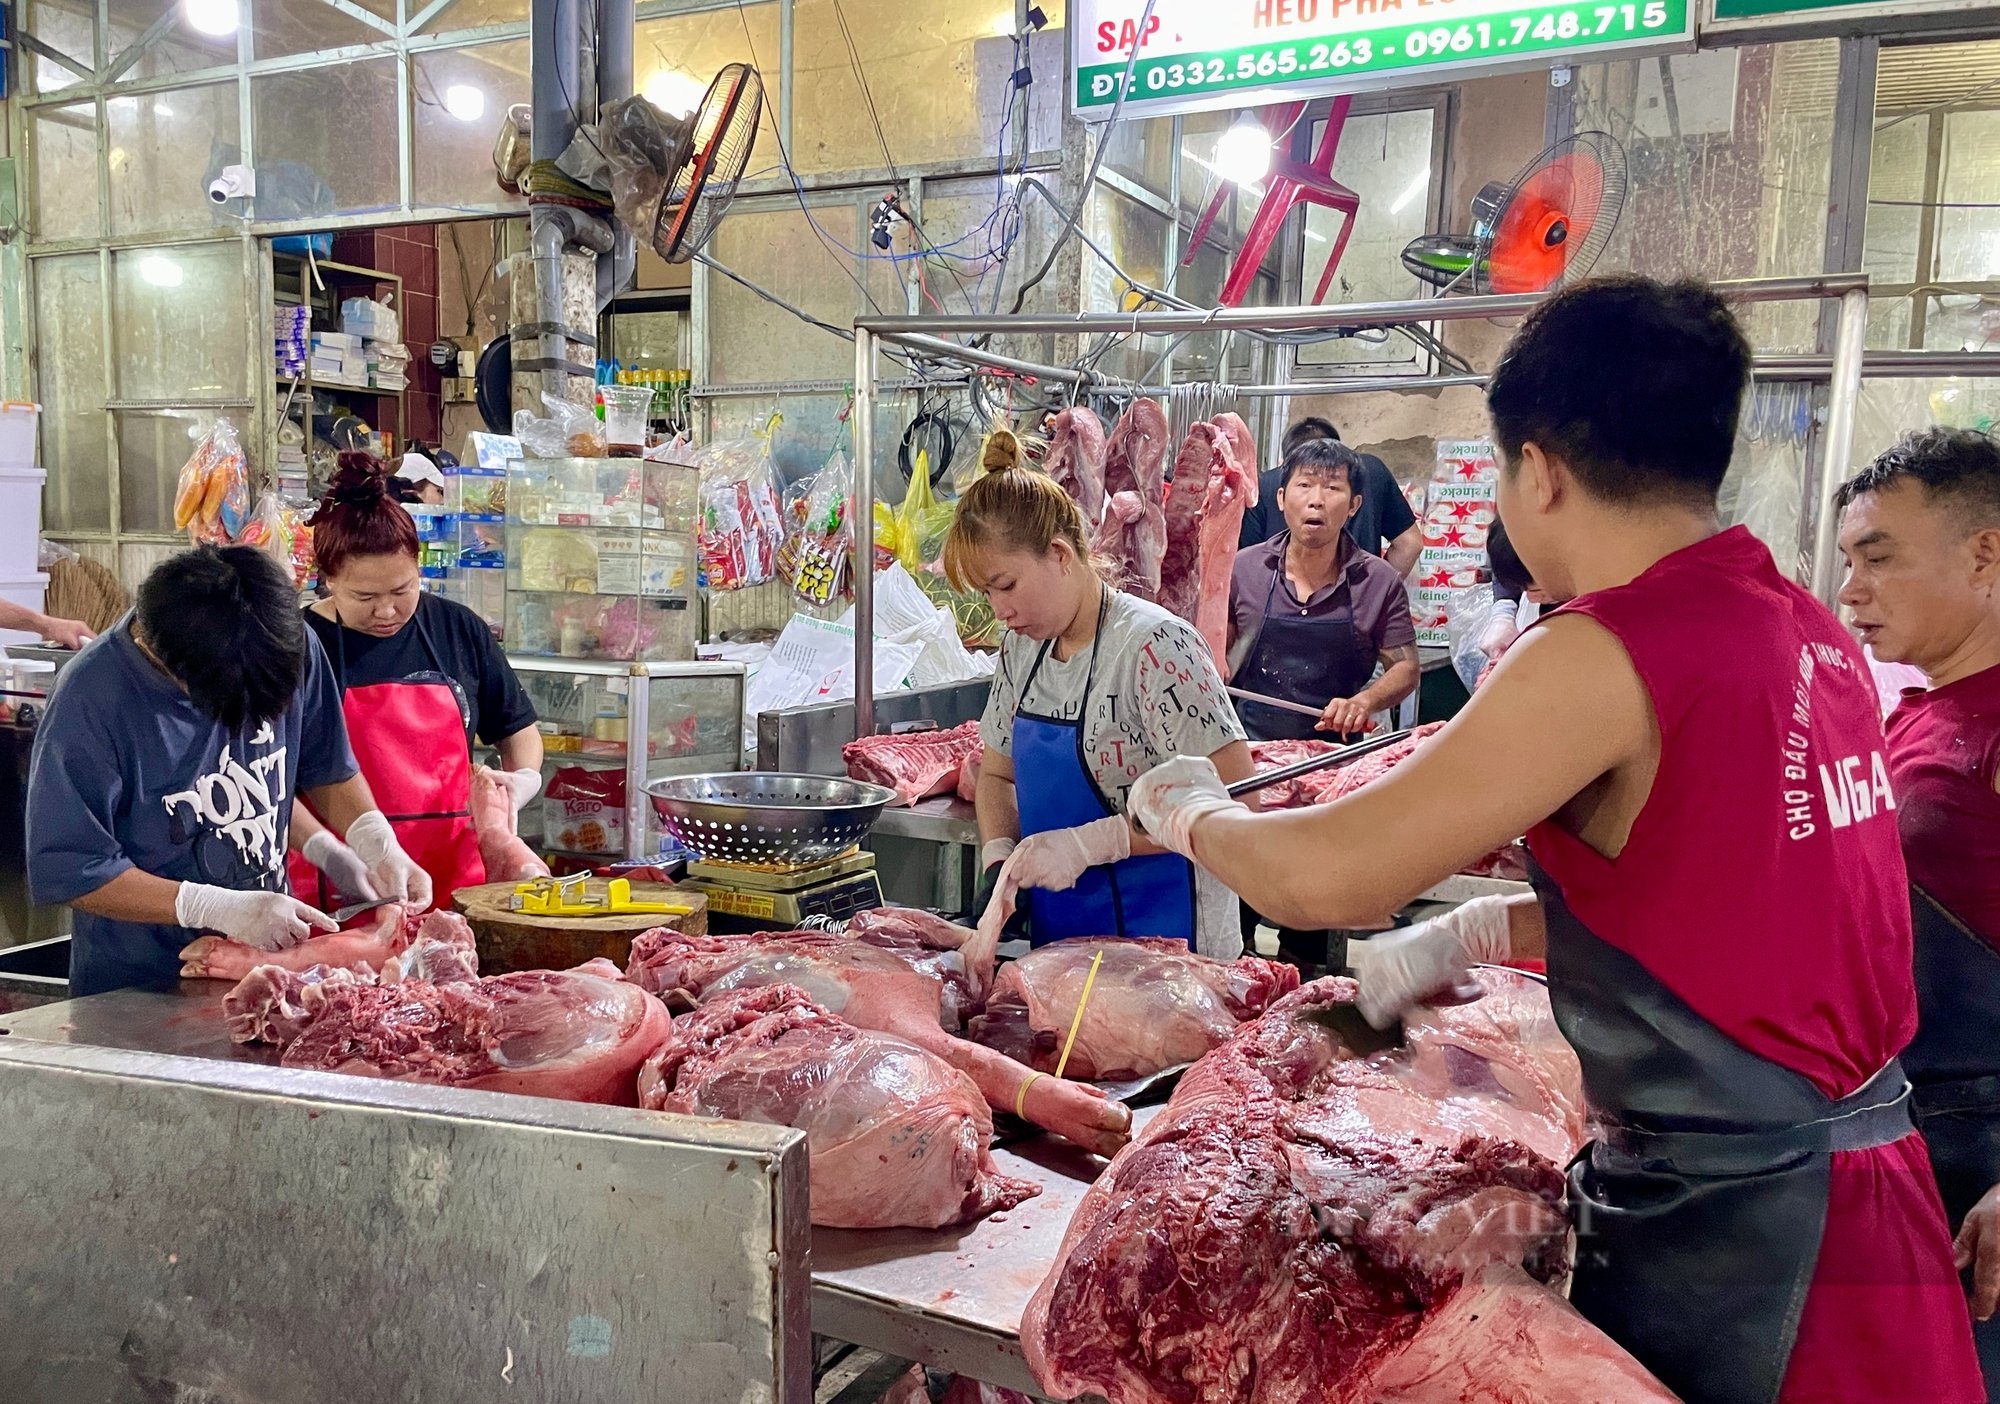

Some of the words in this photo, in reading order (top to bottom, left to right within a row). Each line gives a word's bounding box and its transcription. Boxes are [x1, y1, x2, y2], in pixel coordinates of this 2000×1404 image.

[1146, 38, 1373, 90] 0332.565.263
[1405, 1, 1667, 58] 0961.748.715
[564, 798, 602, 816] Karo
